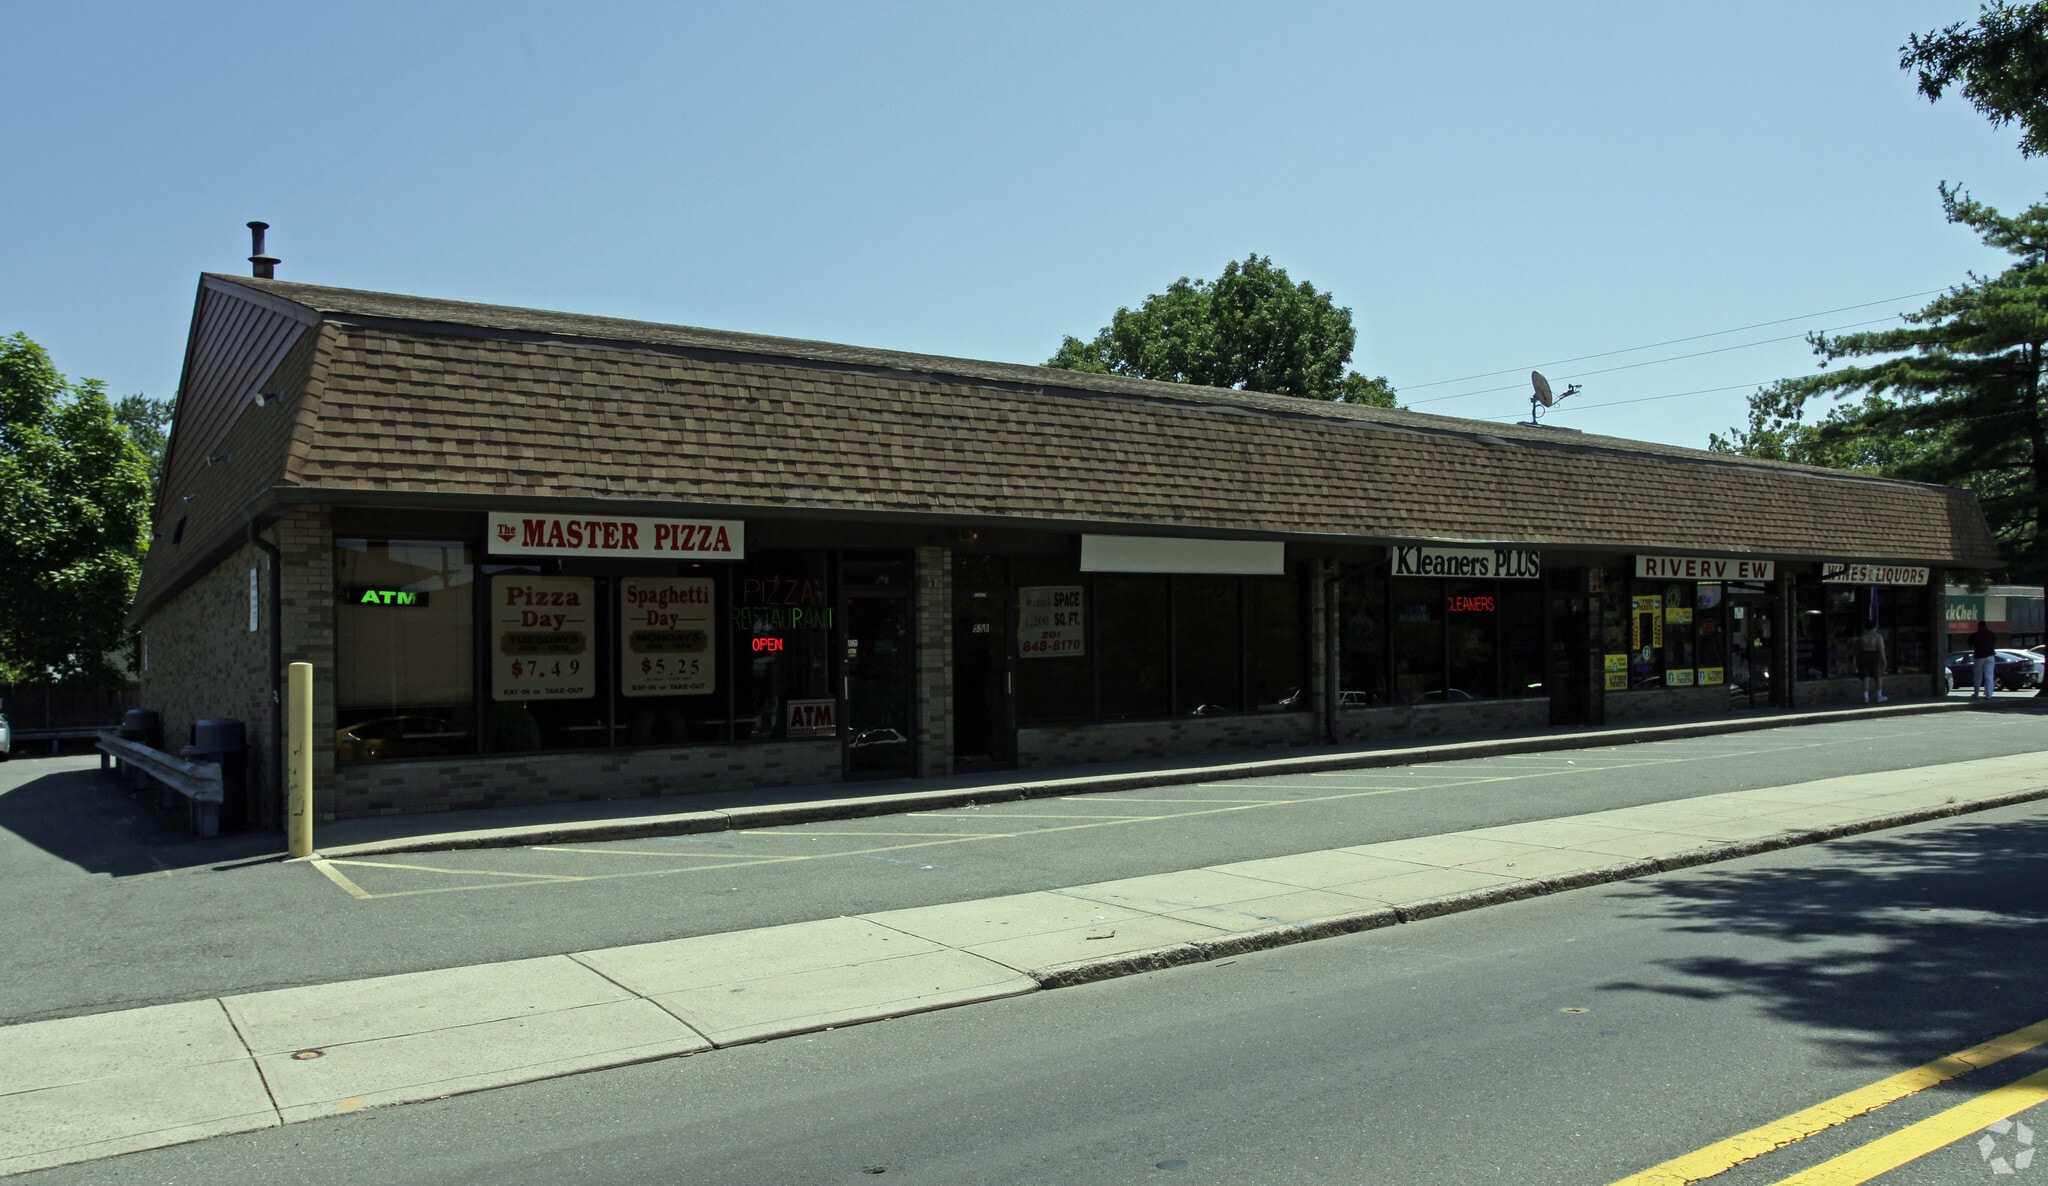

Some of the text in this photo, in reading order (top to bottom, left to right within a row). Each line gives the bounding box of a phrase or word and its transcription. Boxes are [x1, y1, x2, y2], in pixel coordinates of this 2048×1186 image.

[497, 519, 731, 552] The MASTER PIZZA
[1396, 546, 1540, 577] Kleaners PLUS
[1876, 567, 1925, 584] LIQUORS
[360, 590, 417, 605] ATM
[506, 586, 581, 606] Pizza
[627, 585, 709, 609] Spaghetti
[743, 578, 815, 605] PIZZA
[1053, 592, 1080, 607] SPACE
[521, 610, 566, 631] Day
[646, 610, 679, 630] Day
[731, 606, 835, 630] RESTAURANT
[1945, 603, 1978, 621] ckChek
[510, 635, 579, 644] TUESDAYS
[636, 633, 700, 643] MONDAYS
[751, 637, 784, 652] OPEN
[1041, 631, 1061, 639] 201
[1023, 639, 1080, 652] 848-8170
[791, 705, 832, 727] ATM
